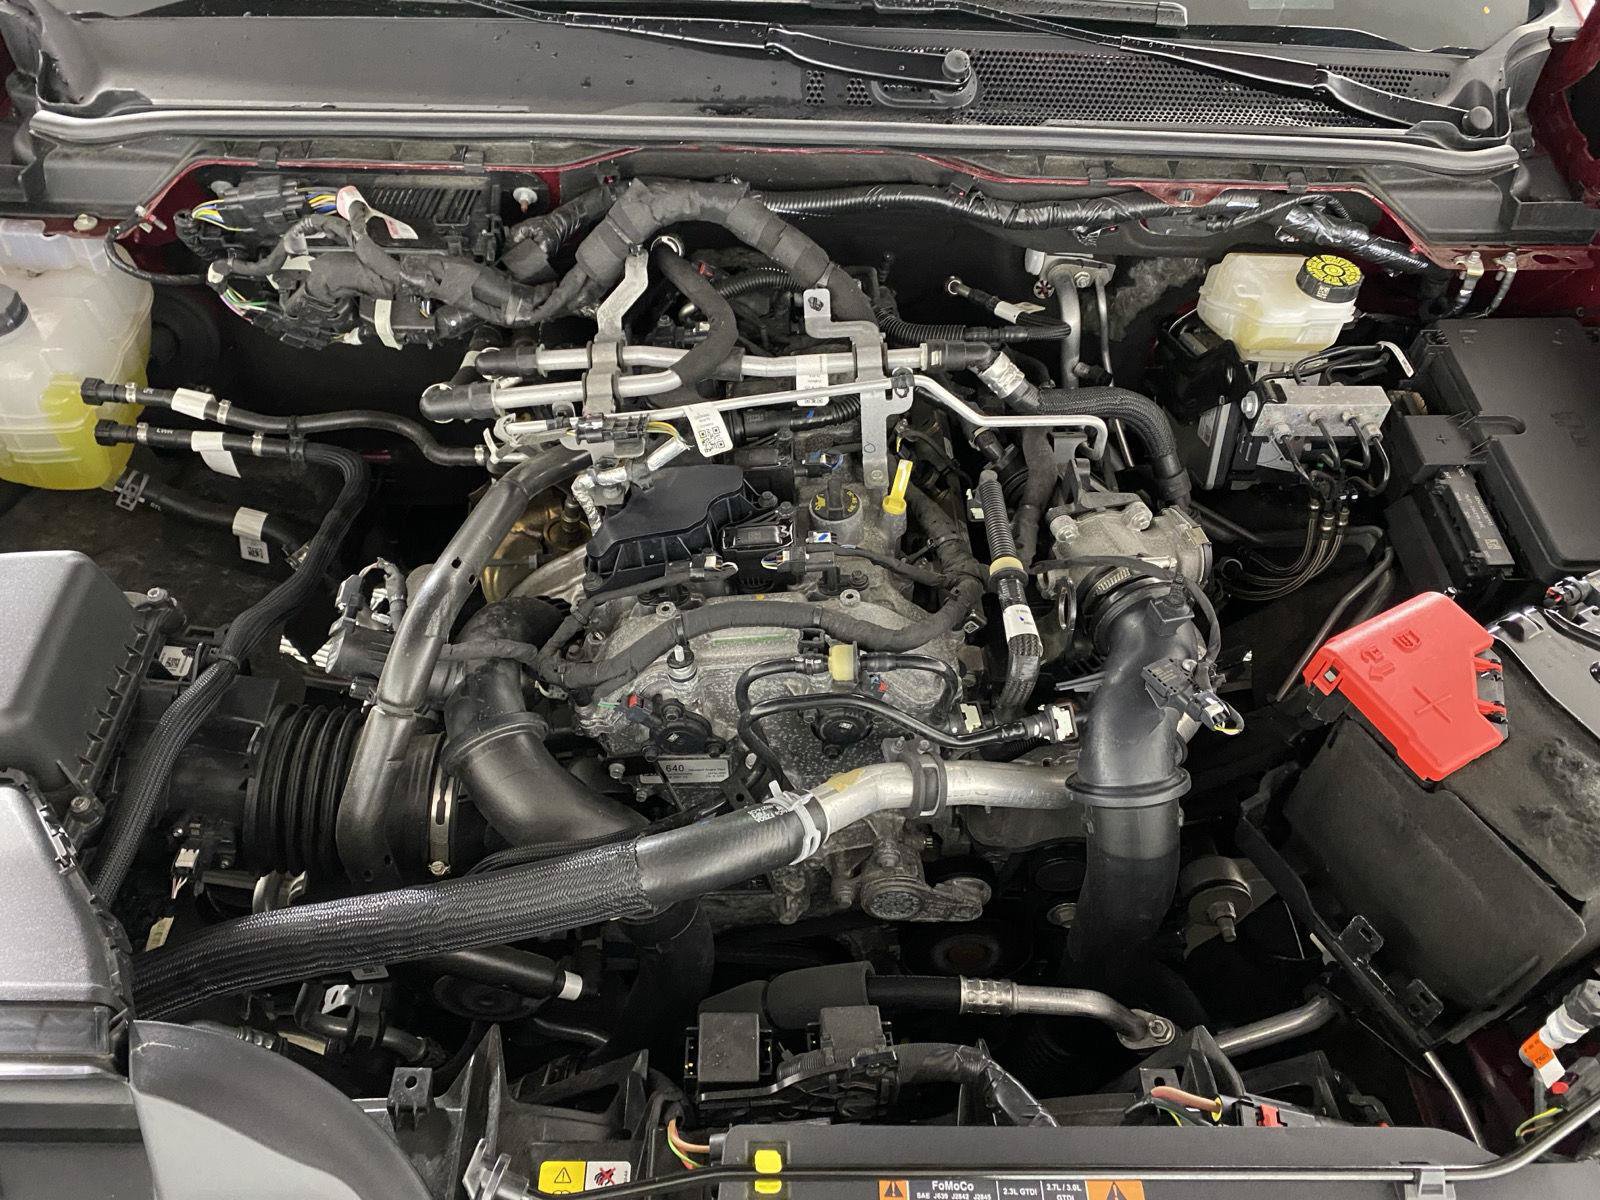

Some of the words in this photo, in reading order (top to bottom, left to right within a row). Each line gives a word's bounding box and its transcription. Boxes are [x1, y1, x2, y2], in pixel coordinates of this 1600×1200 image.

[666, 764, 685, 772] 640
[931, 1180, 975, 1191] FoMoCo
[1002, 1187, 1018, 1195] 2.3L
[1019, 1188, 1038, 1196] GTDI
